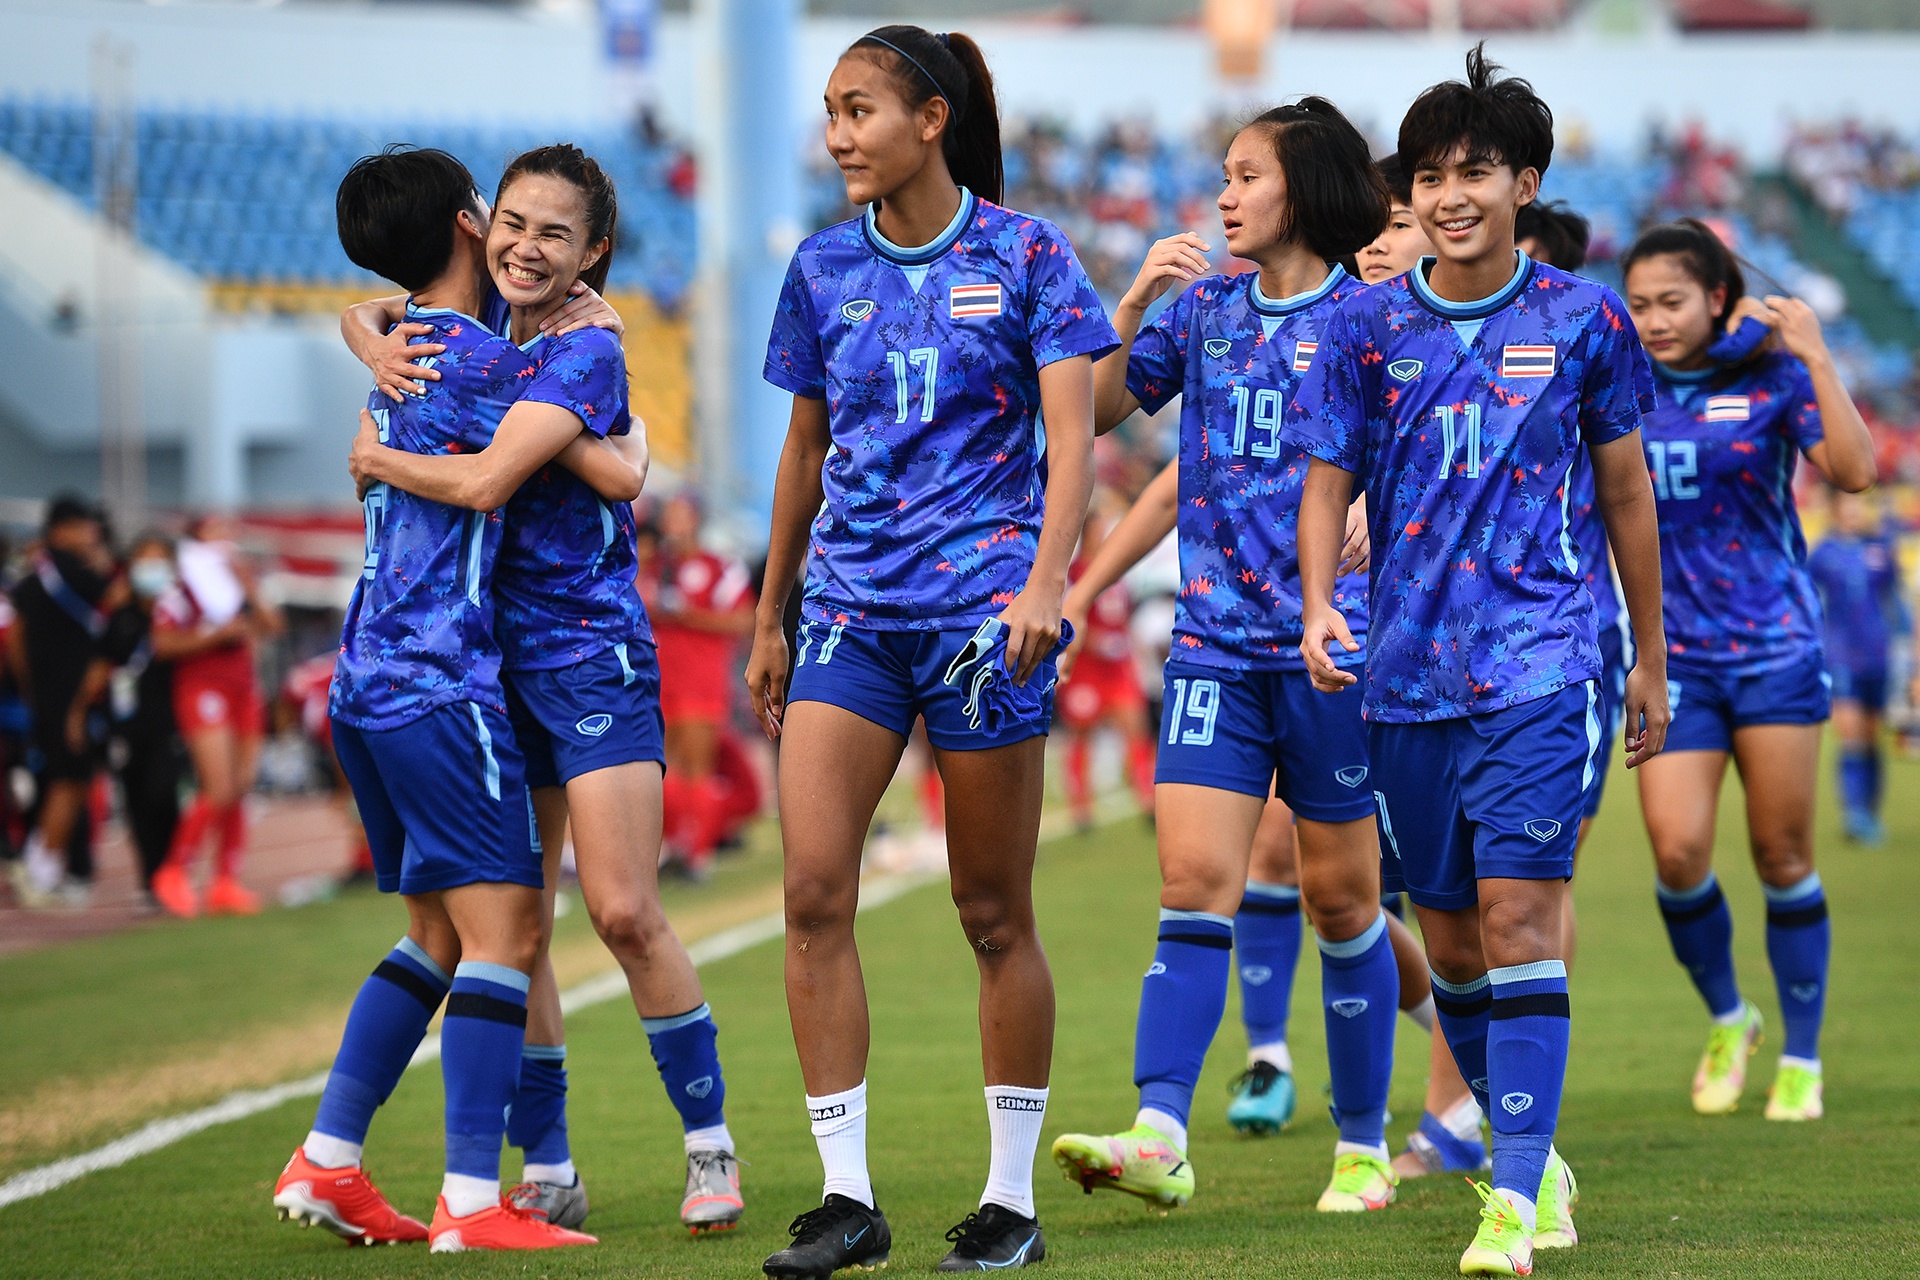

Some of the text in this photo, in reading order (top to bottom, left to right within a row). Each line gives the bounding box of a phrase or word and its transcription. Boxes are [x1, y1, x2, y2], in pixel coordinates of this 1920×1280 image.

[886, 346, 939, 424] 17
[1232, 385, 1283, 459] 19
[1435, 402, 1481, 479] 11
[1647, 440, 1701, 500] 12
[1167, 678, 1221, 746] 19
[997, 1097, 1044, 1111] SONAR
